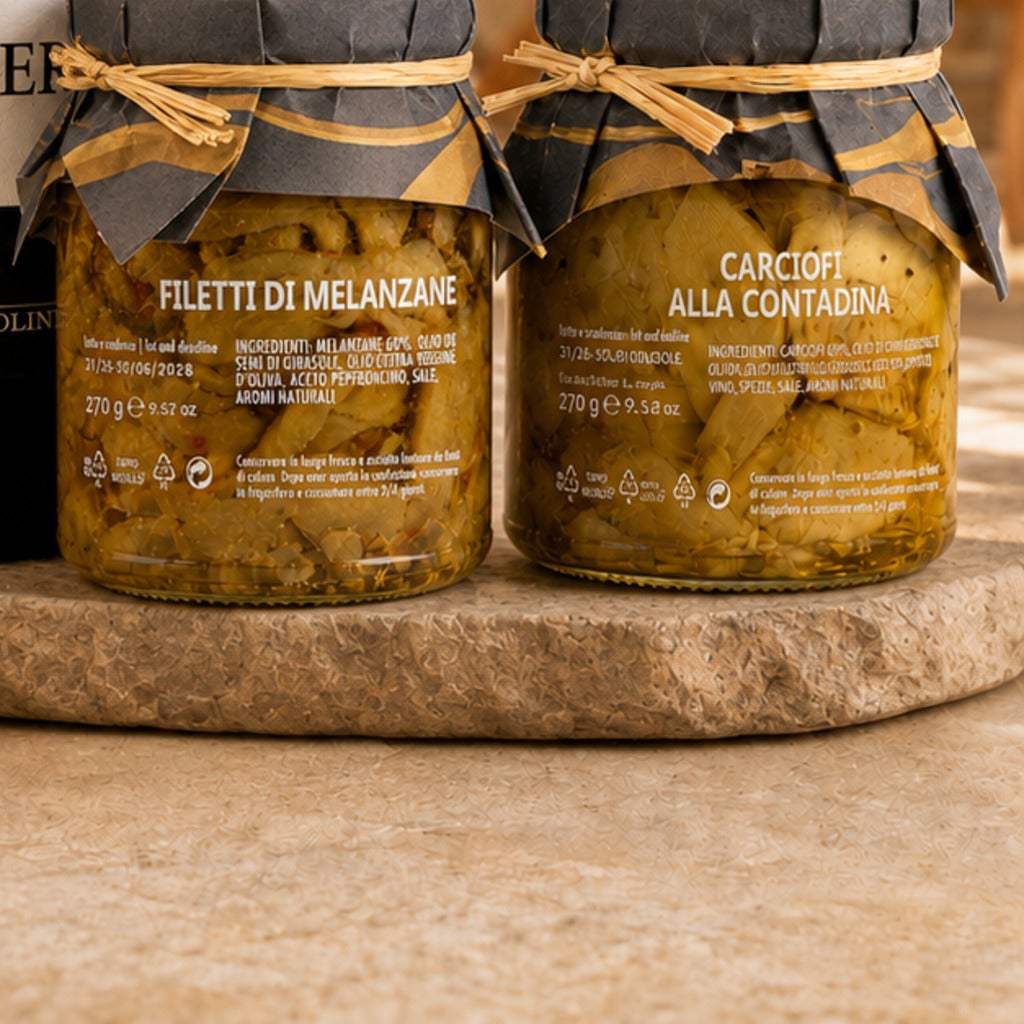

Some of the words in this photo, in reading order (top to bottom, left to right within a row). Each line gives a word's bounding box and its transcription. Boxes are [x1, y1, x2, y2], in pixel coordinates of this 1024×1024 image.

[720, 251, 842, 281] CARCIOFI
[160, 278, 257, 311] FILETTI
[264, 279, 296, 311] DI
[304, 275, 457, 311] MELANZANE
[668, 287, 734, 318] ALLA
[742, 285, 891, 318] CONTADINA
[86, 396, 110, 416] 270
[114, 400, 123, 421] g
[180, 405, 197, 416] oz
[559, 392, 585, 413] 270
[589, 397, 599, 418] g
[664, 404, 680, 416] oz
